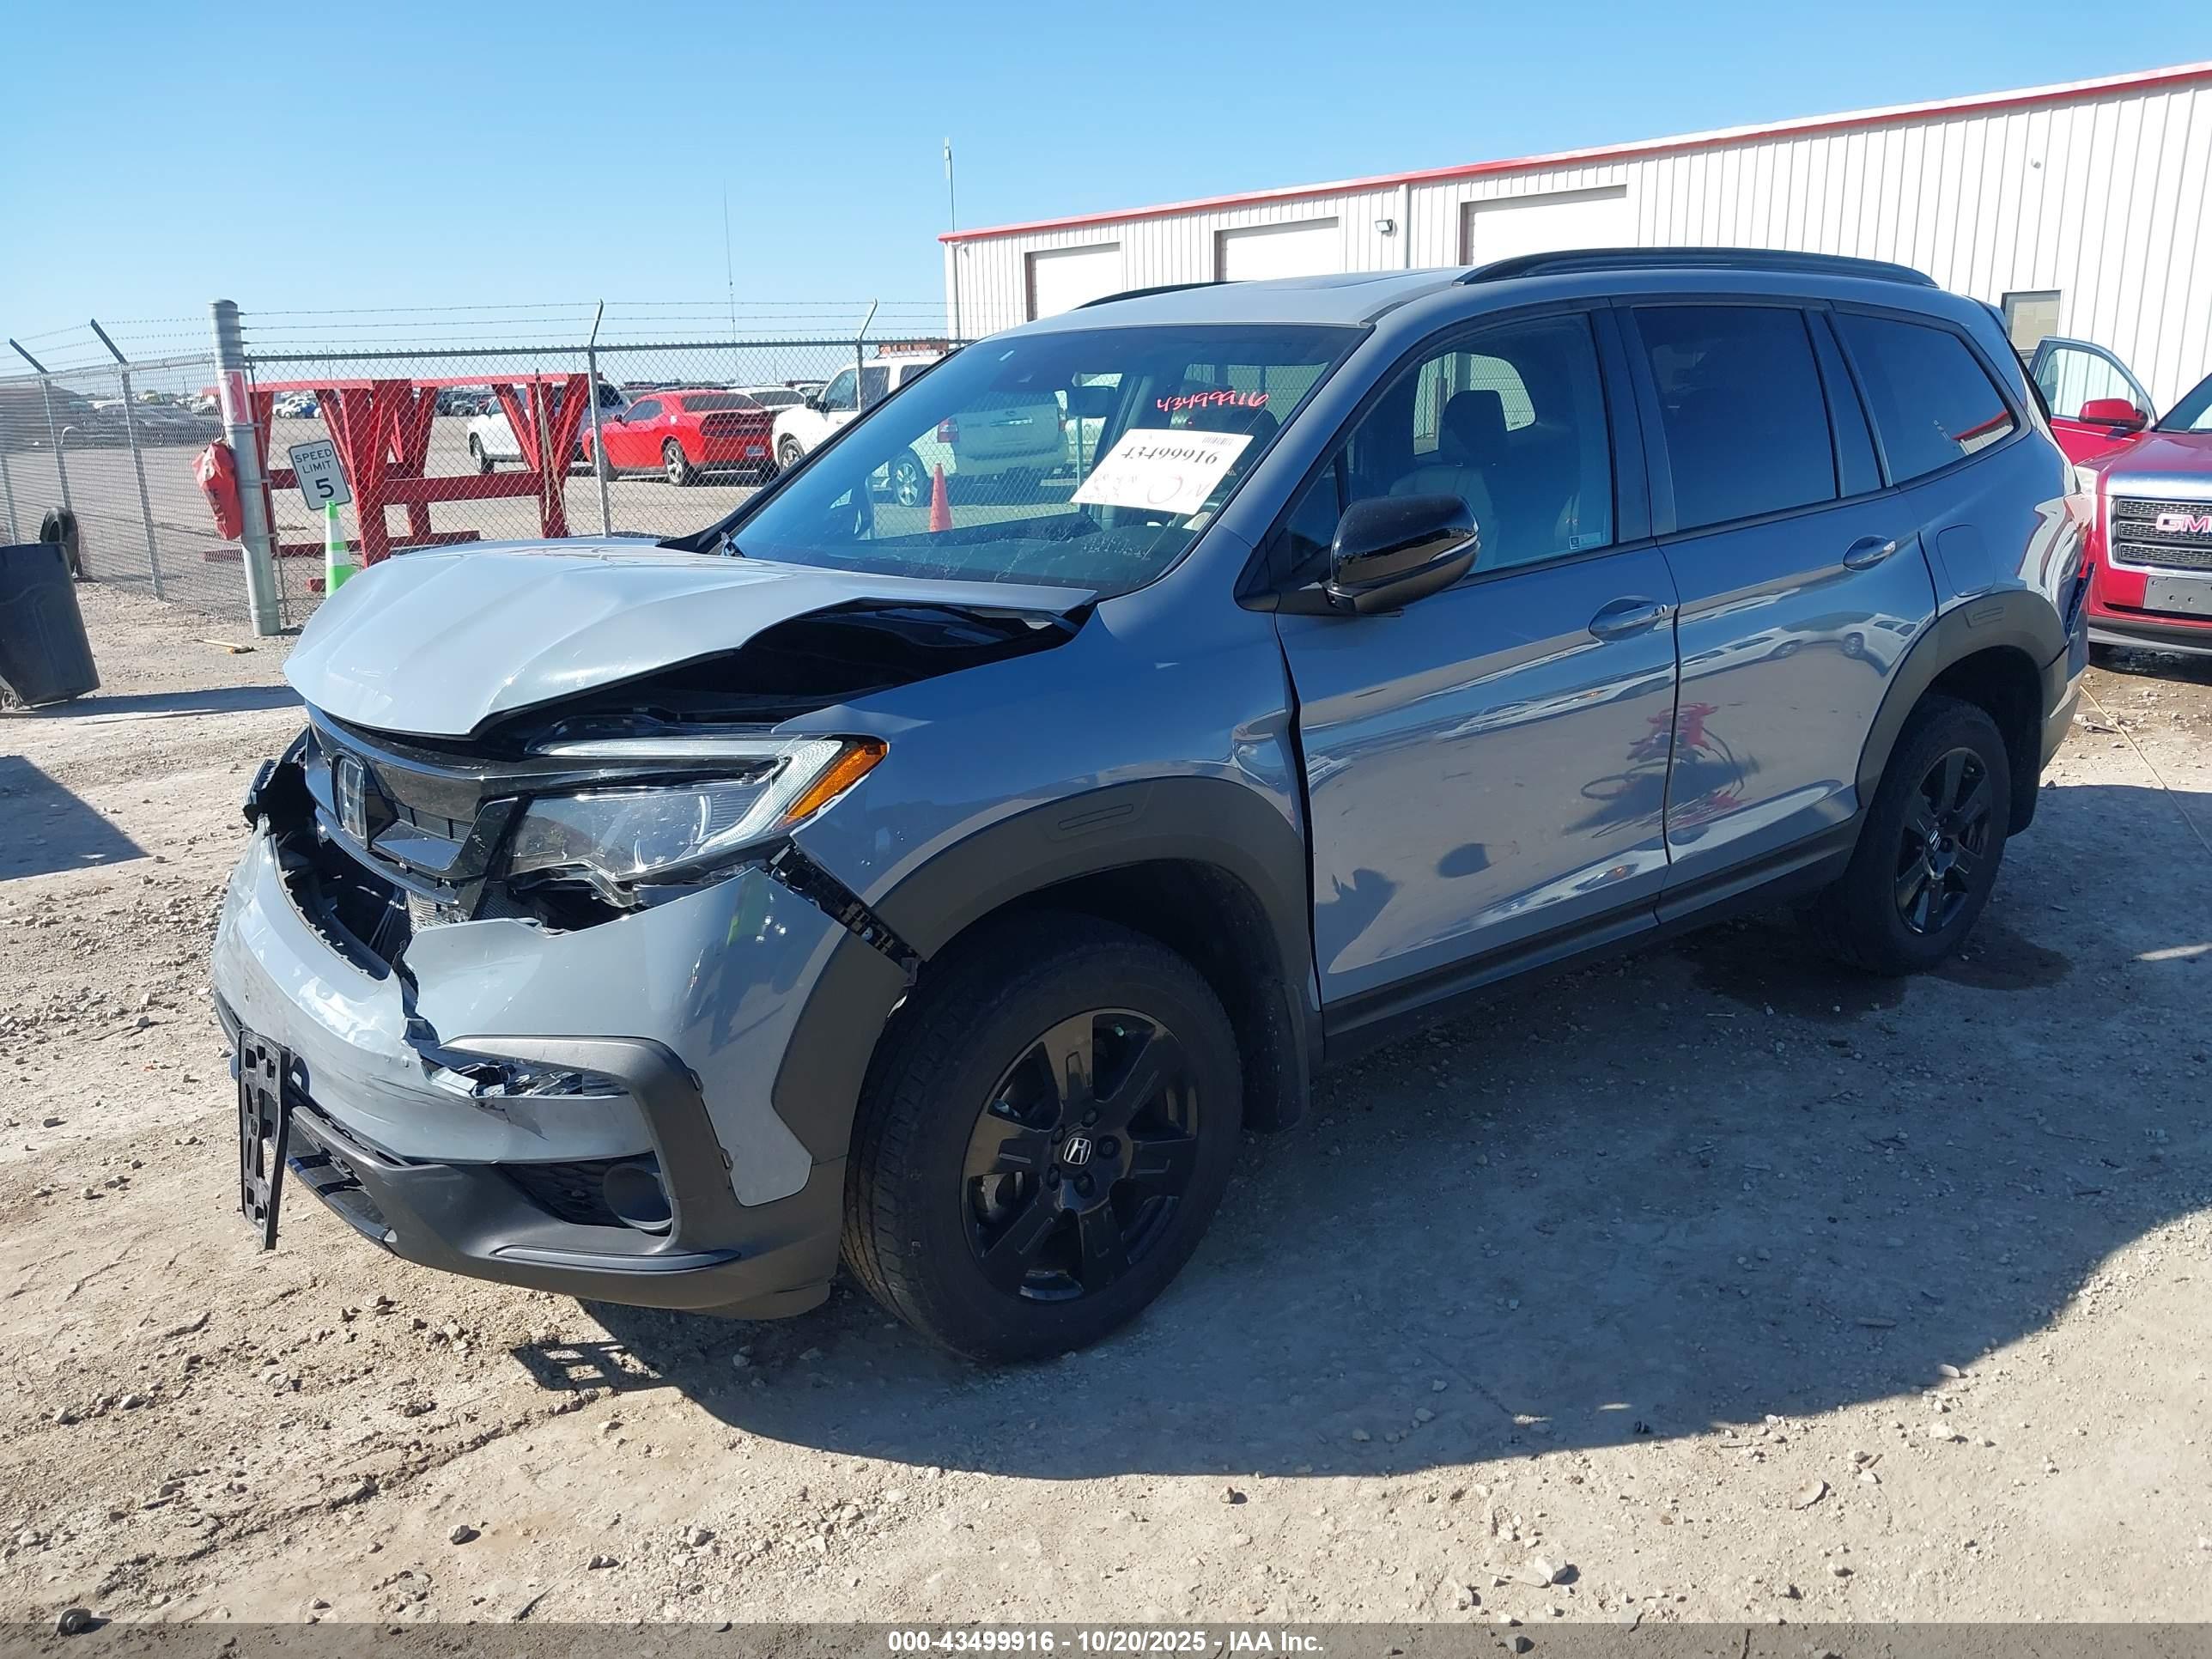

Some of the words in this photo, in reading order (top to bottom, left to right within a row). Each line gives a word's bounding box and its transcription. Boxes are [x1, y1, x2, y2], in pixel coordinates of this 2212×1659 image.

[1156, 390, 1269, 412] 43499916
[295, 448, 332, 463] SPEED
[1121, 446, 1219, 465] 43499916
[301, 460, 331, 474] LIMIT
[315, 477, 335, 498] 5
[2155, 513, 2212, 532] GM
